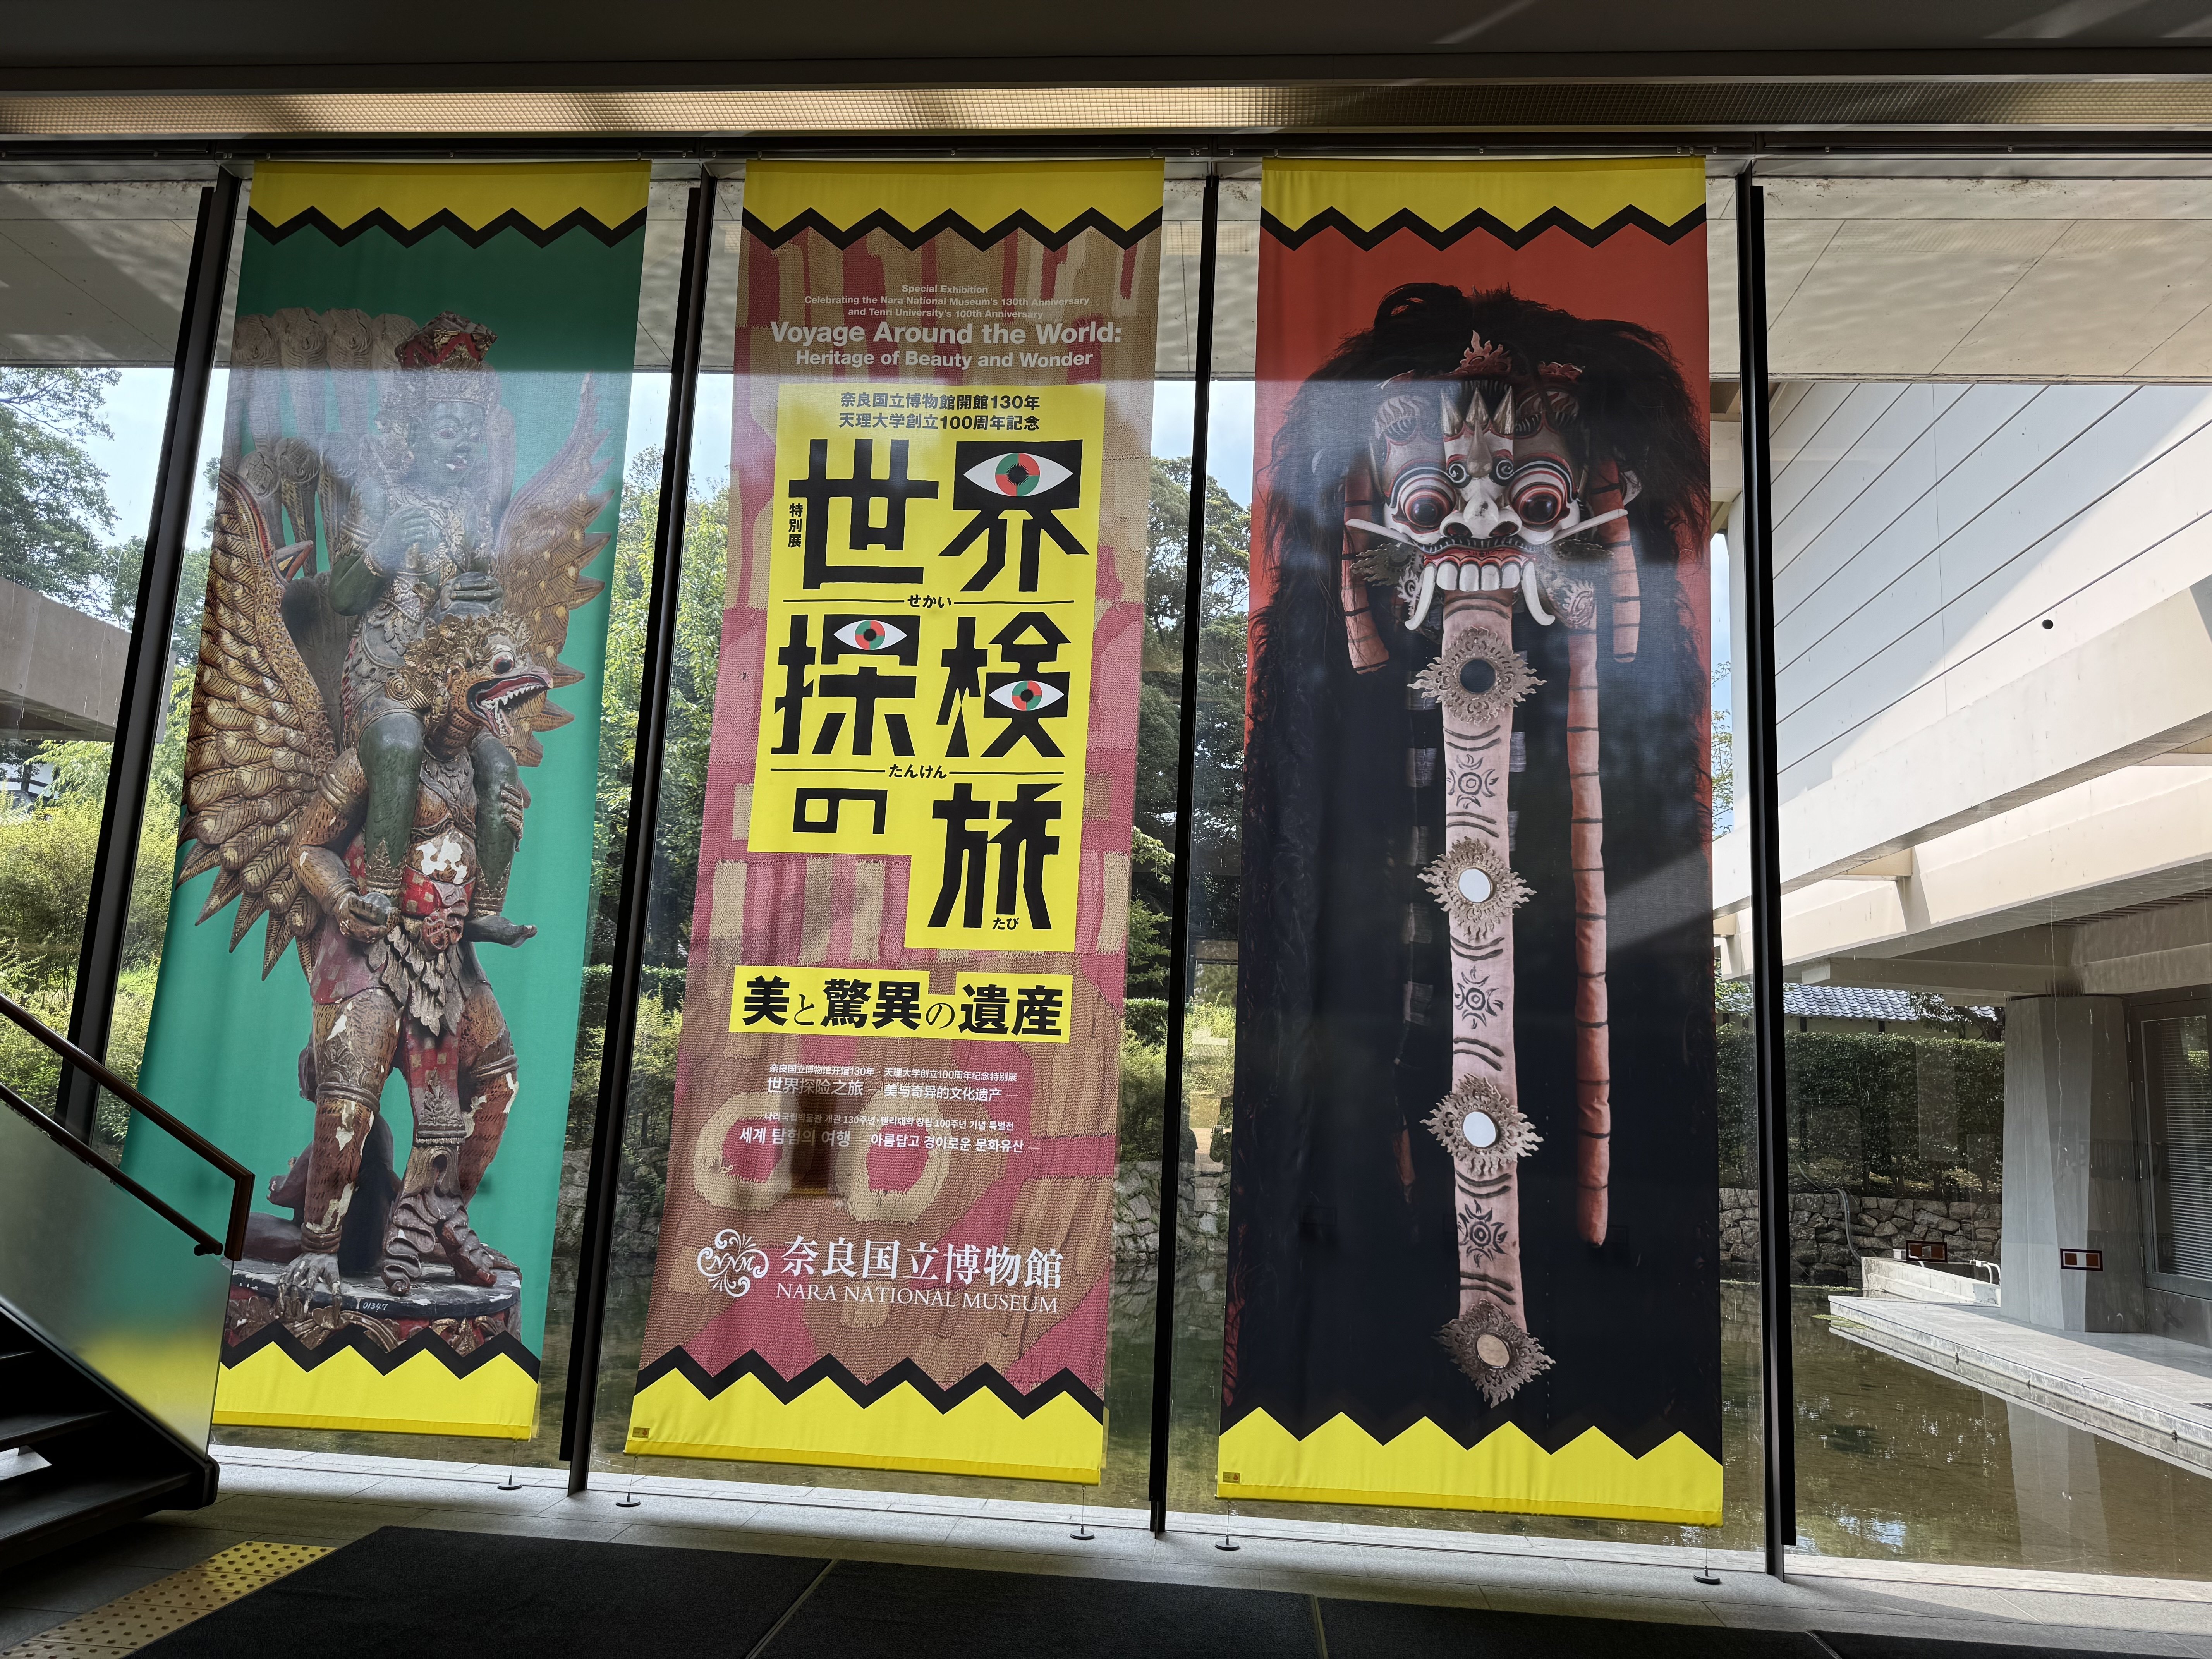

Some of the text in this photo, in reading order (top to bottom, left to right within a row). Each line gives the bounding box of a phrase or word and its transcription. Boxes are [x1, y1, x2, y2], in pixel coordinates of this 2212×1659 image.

[902, 285, 988, 294] Special Exhibition
[805, 296, 859, 305] Celebrating
[881, 296, 903, 304] Nara
[906, 297, 946, 305] National
[1031, 297, 1090, 306] Anniversary
[895, 309, 951, 318] University's
[985, 310, 1043, 319] Anniversary
[770, 321, 1121, 347] Voyage Around the World:
[796, 350, 1094, 370] Heritage of Beauty and Wonder
[840, 392, 1040, 410] 奈良国立博物館開館130年
[838, 412, 1040, 431] 天理大学創立100周年記念
[788, 438, 1090, 592] 世界
[787, 503, 804, 548] 特別展
[907, 595, 952, 608] せかい
[771, 612, 1072, 758] 探検
[888, 764, 947, 779] たんけん
[992, 917, 1019, 930] たび
[742, 975, 1063, 1036] 美と驚異の遺産
[767, 1077, 1002, 1101] 世界探险之旅 美与奇异的文化遗产
[825, 1115, 842, 1124] 개관
[917, 1118, 933, 1127] 창립
[934, 1119, 967, 1129] 100주년
[969, 1121, 986, 1130] 기념
[989, 1121, 1014, 1132] 특별전
[739, 1127, 1025, 1154] 세계 탐험의 여행 아름답고 경이로운 문화유산
[780, 1235, 1063, 1289] 奈良国立博物館
[363, 1302, 388, 1310] 01347
[776, 1283, 1058, 1313] NARA NATIONAL MUSEUM
